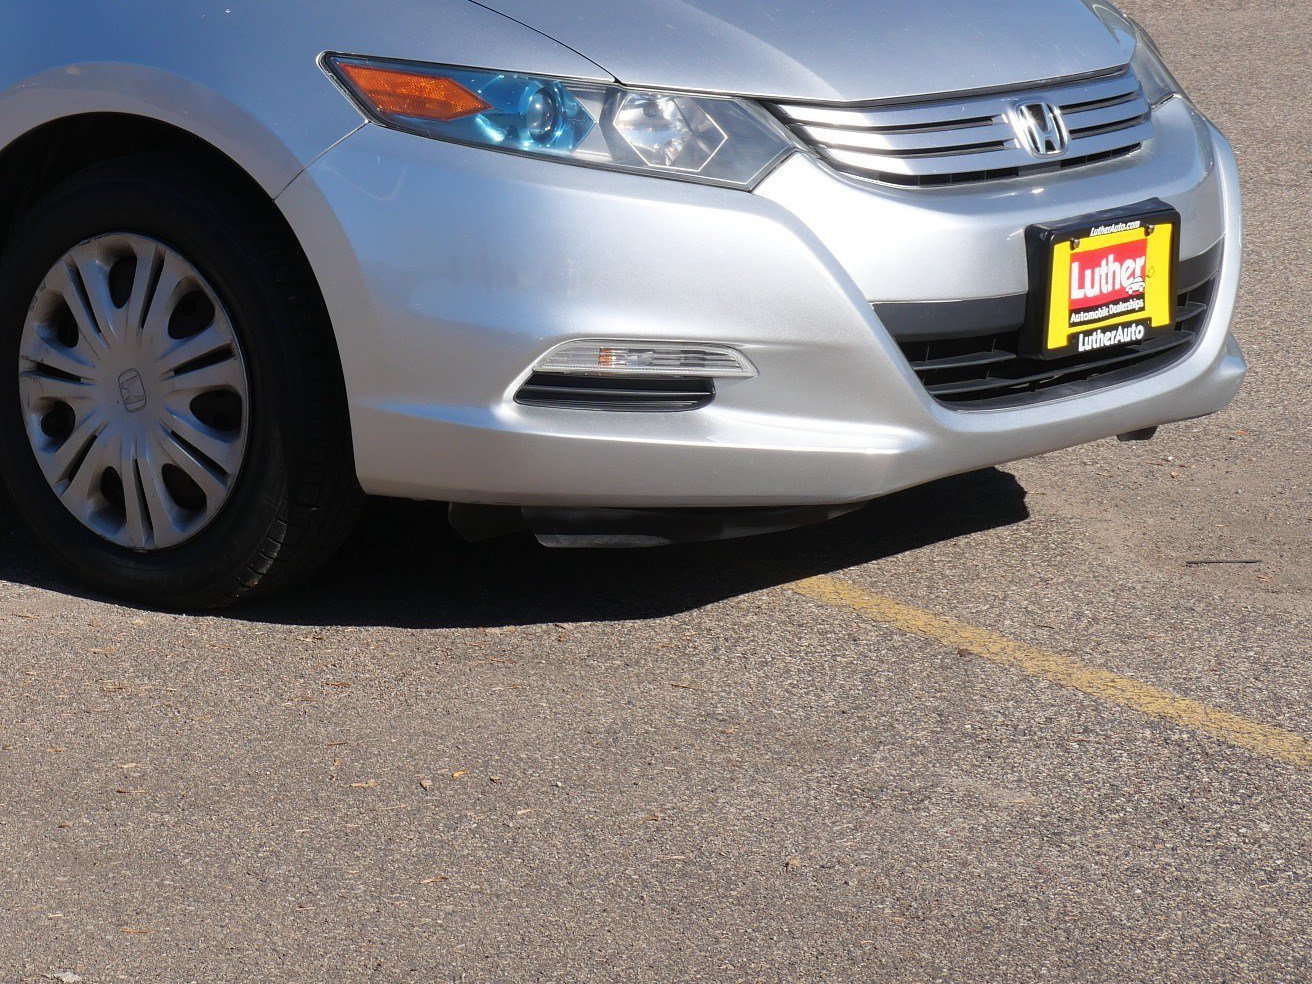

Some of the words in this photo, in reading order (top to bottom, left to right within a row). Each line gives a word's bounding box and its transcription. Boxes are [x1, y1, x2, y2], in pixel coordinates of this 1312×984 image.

[1090, 221, 1140, 236] LutherAuto.com
[1071, 254, 1145, 299] Luther
[1070, 306, 1108, 323] Automobile
[1109, 299, 1144, 313] Dealerships
[1078, 323, 1145, 352] LutherAuto
